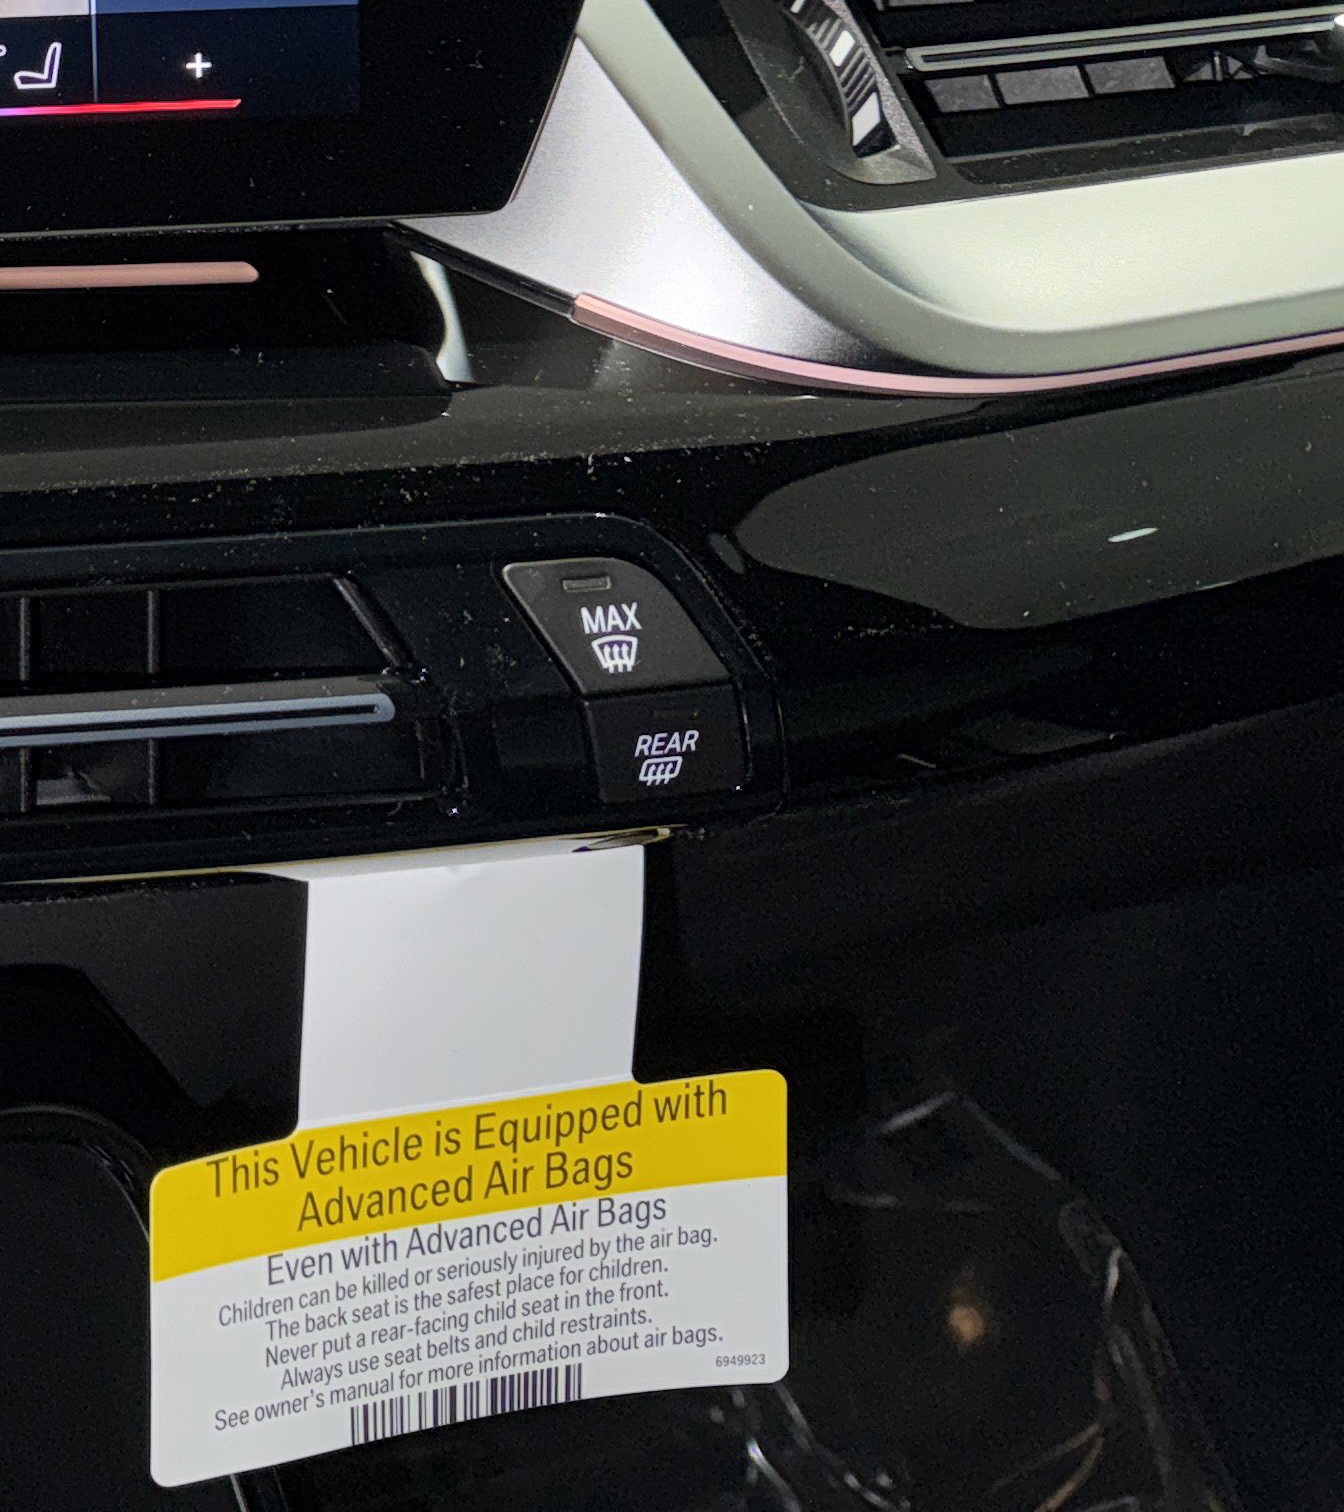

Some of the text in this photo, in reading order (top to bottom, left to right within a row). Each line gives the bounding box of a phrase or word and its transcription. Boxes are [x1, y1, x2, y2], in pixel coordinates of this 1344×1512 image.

[580, 601, 643, 635] MAX
[634, 729, 700, 758] REAR
[206, 1079, 728, 1198] This Vehicle is Equipped with
[297, 1149, 634, 1232] Advanced Air Bags
[218, 1225, 718, 1328] Children can be killed or seriously injured by the air bag.
[267, 1196, 667, 1286] Even with Advanced Air Bags
[265, 1257, 669, 1342] The back seat is the safest place for children.
[265, 1278, 669, 1368] Never put a rear-facing child seat in the front.
[214, 1408, 250, 1432] See
[330, 1372, 395, 1406] manual
[398, 1368, 424, 1390] for
[428, 1361, 474, 1385] more
[478, 1340, 582, 1375] information
[586, 1330, 640, 1357] about
[644, 1327, 668, 1348] air
[672, 1325, 724, 1348] bags.
[280, 1306, 653, 1391] Always use seat belts and child restraints.
[715, 1353, 767, 1368] 6949923
